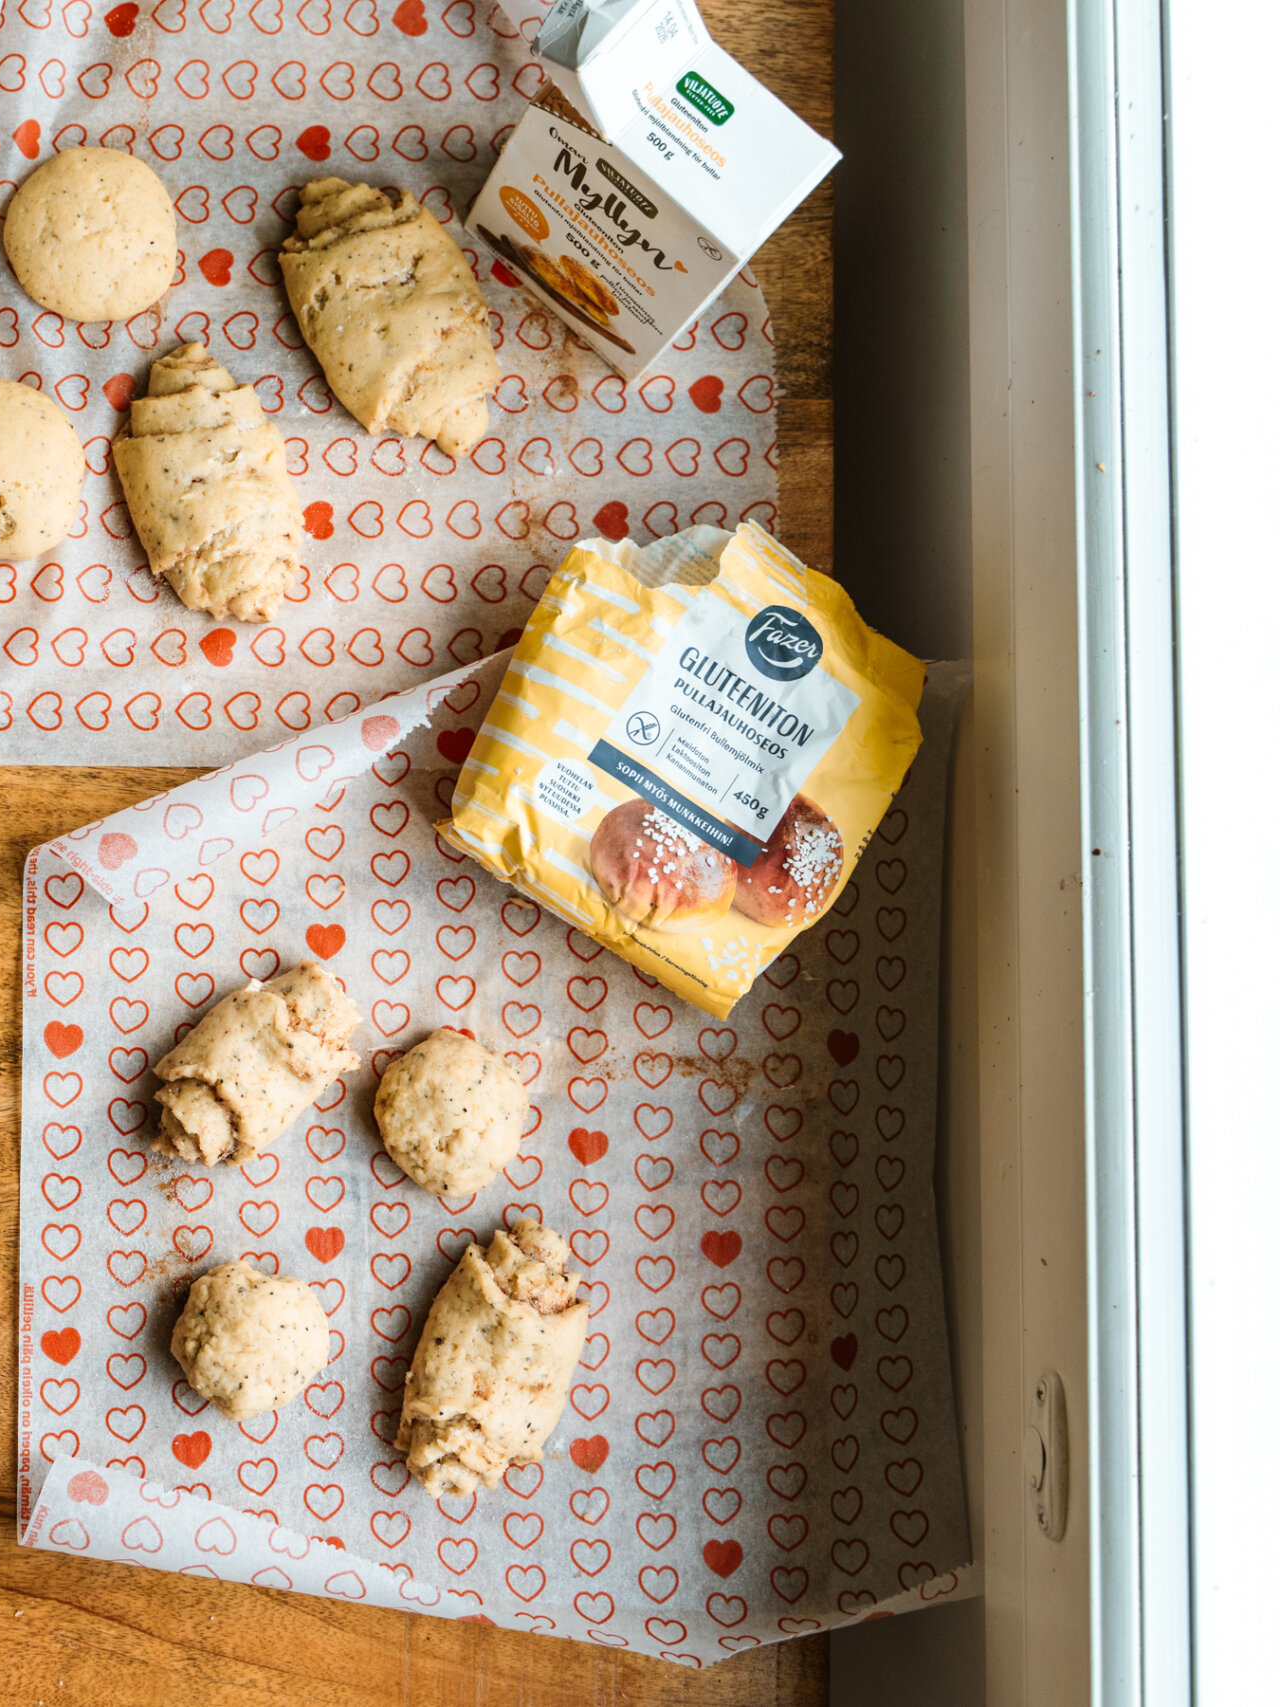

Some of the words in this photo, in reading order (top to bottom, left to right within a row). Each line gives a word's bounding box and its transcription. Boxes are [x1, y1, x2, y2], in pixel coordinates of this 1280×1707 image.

[670, 97, 709, 133] Gluteeniton
[683, 77, 728, 120] VILJATUOTE
[548, 125, 589, 165] Oman
[644, 81, 728, 167] Pullajauhoseos
[645, 131, 667, 152] 500
[664, 149, 674, 161] g
[648, 113, 693, 156] mjölblandning
[691, 152, 702, 164] för
[700, 161, 721, 181] bullar
[550, 147, 672, 268] Myllyn
[572, 202, 624, 254] Gluteeniton
[531, 173, 657, 297] Pullajauhoseos
[533, 189, 563, 220] Glutenfri
[611, 265, 623, 277] för
[621, 276, 643, 296] bullar
[564, 232, 590, 258] 500
[589, 257, 601, 269] g
[748, 609, 821, 657] Fazer
[676, 643, 815, 748] GLUTEENITON
[668, 702, 712, 737] Glutenfri
[709, 730, 765, 774] Bullemjölmix
[673, 677, 788, 761] PULLAJAUHOSEOS
[670, 744, 712, 778] Laktoositon
[676, 735, 711, 764] Maidoton
[548, 778, 581, 803] SUOSIKKI
[555, 762, 594, 790] VUOHELAN
[557, 774, 581, 792] TUTTU
[665, 752, 719, 796] Kananmunaton
[537, 781, 552, 795] NYT
[550, 790, 582, 814] UUDESSA
[538, 793, 572, 818] PUSSISSA.
[615, 760, 645, 784] SOPII
[641, 777, 670, 802] MYÖS
[666, 798, 734, 847] MUNKKEIHIN!
[732, 788, 770, 820] 450g
